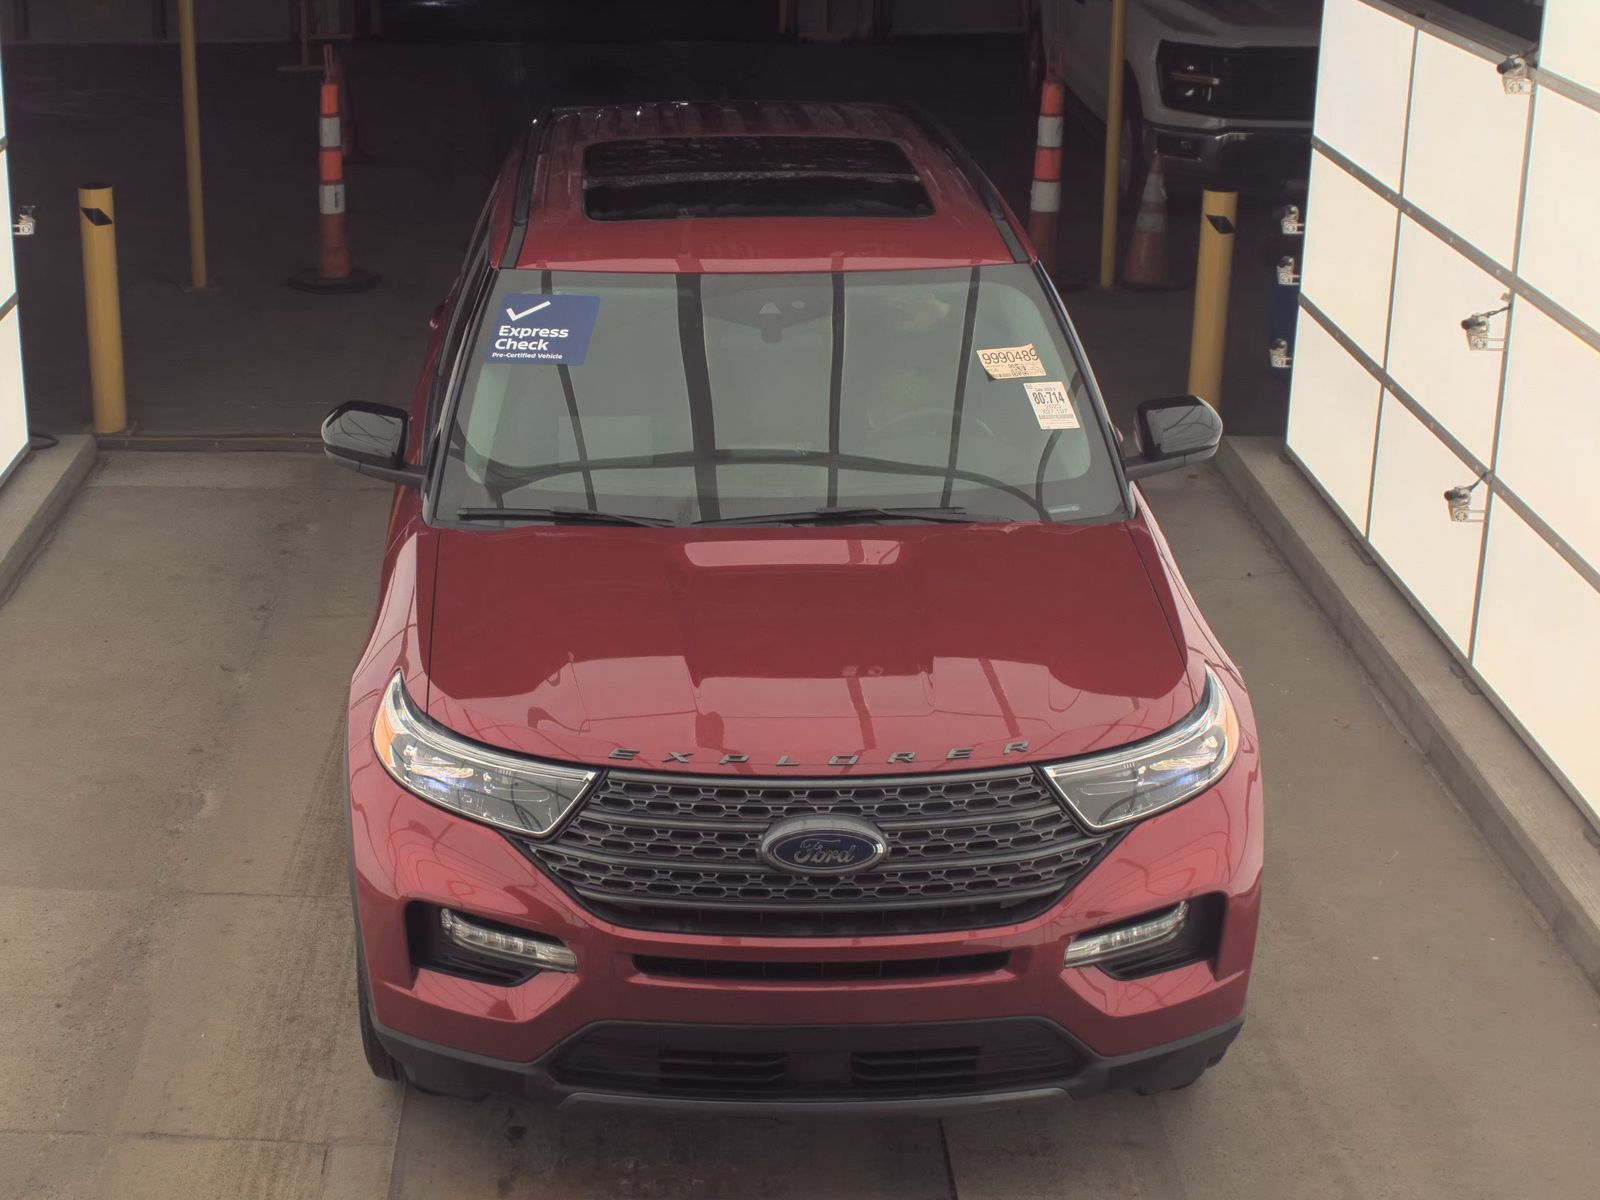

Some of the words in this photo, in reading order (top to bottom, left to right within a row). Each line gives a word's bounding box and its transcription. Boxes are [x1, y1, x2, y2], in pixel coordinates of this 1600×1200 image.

[498, 325, 569, 339] Express
[494, 338, 550, 351] Check
[982, 347, 1039, 365] 9990489
[1032, 391, 1065, 405] 80:714
[608, 742, 1029, 767] EXPLORER
[793, 838, 857, 863] Ford
